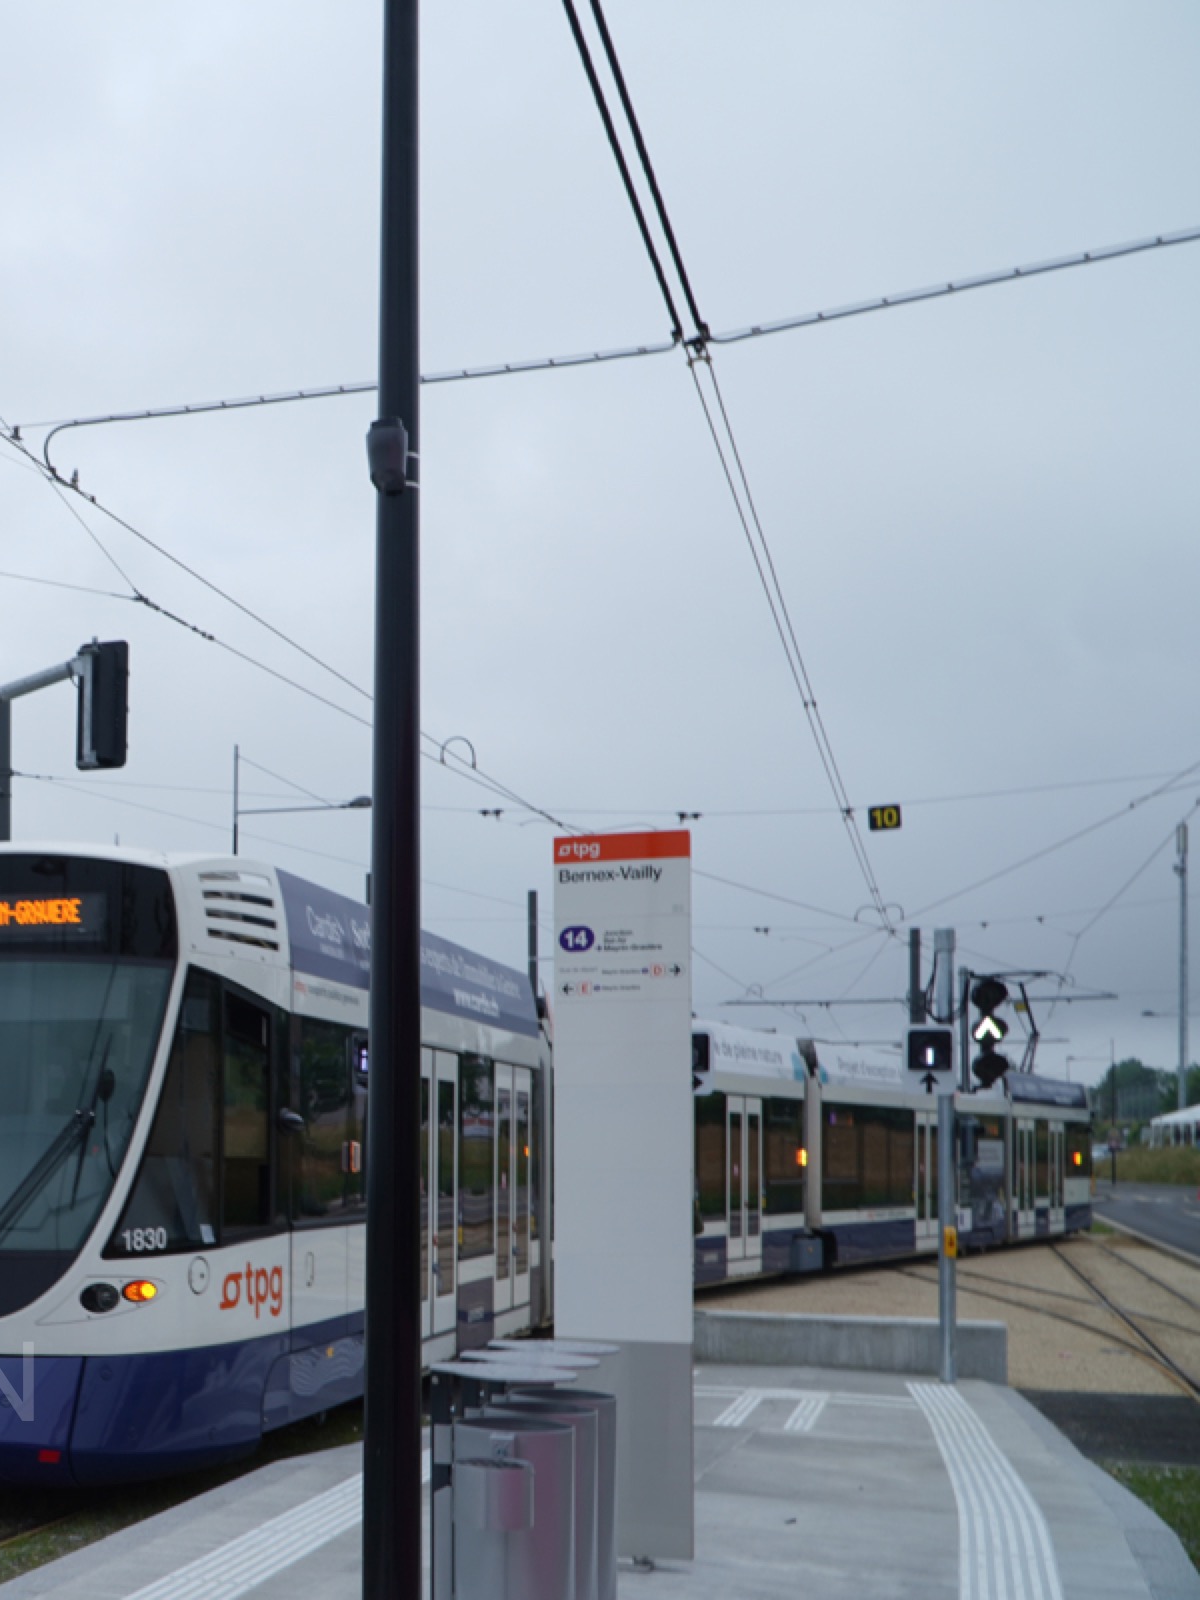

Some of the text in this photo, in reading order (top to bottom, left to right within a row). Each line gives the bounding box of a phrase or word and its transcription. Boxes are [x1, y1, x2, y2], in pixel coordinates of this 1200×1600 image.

[871, 807, 898, 829] 10
[573, 841, 600, 859] tpg
[559, 864, 663, 883] Bernex-Vailly
[563, 929, 589, 949] 14
[122, 1227, 167, 1251] 1830
[246, 1261, 283, 1319] tpg
